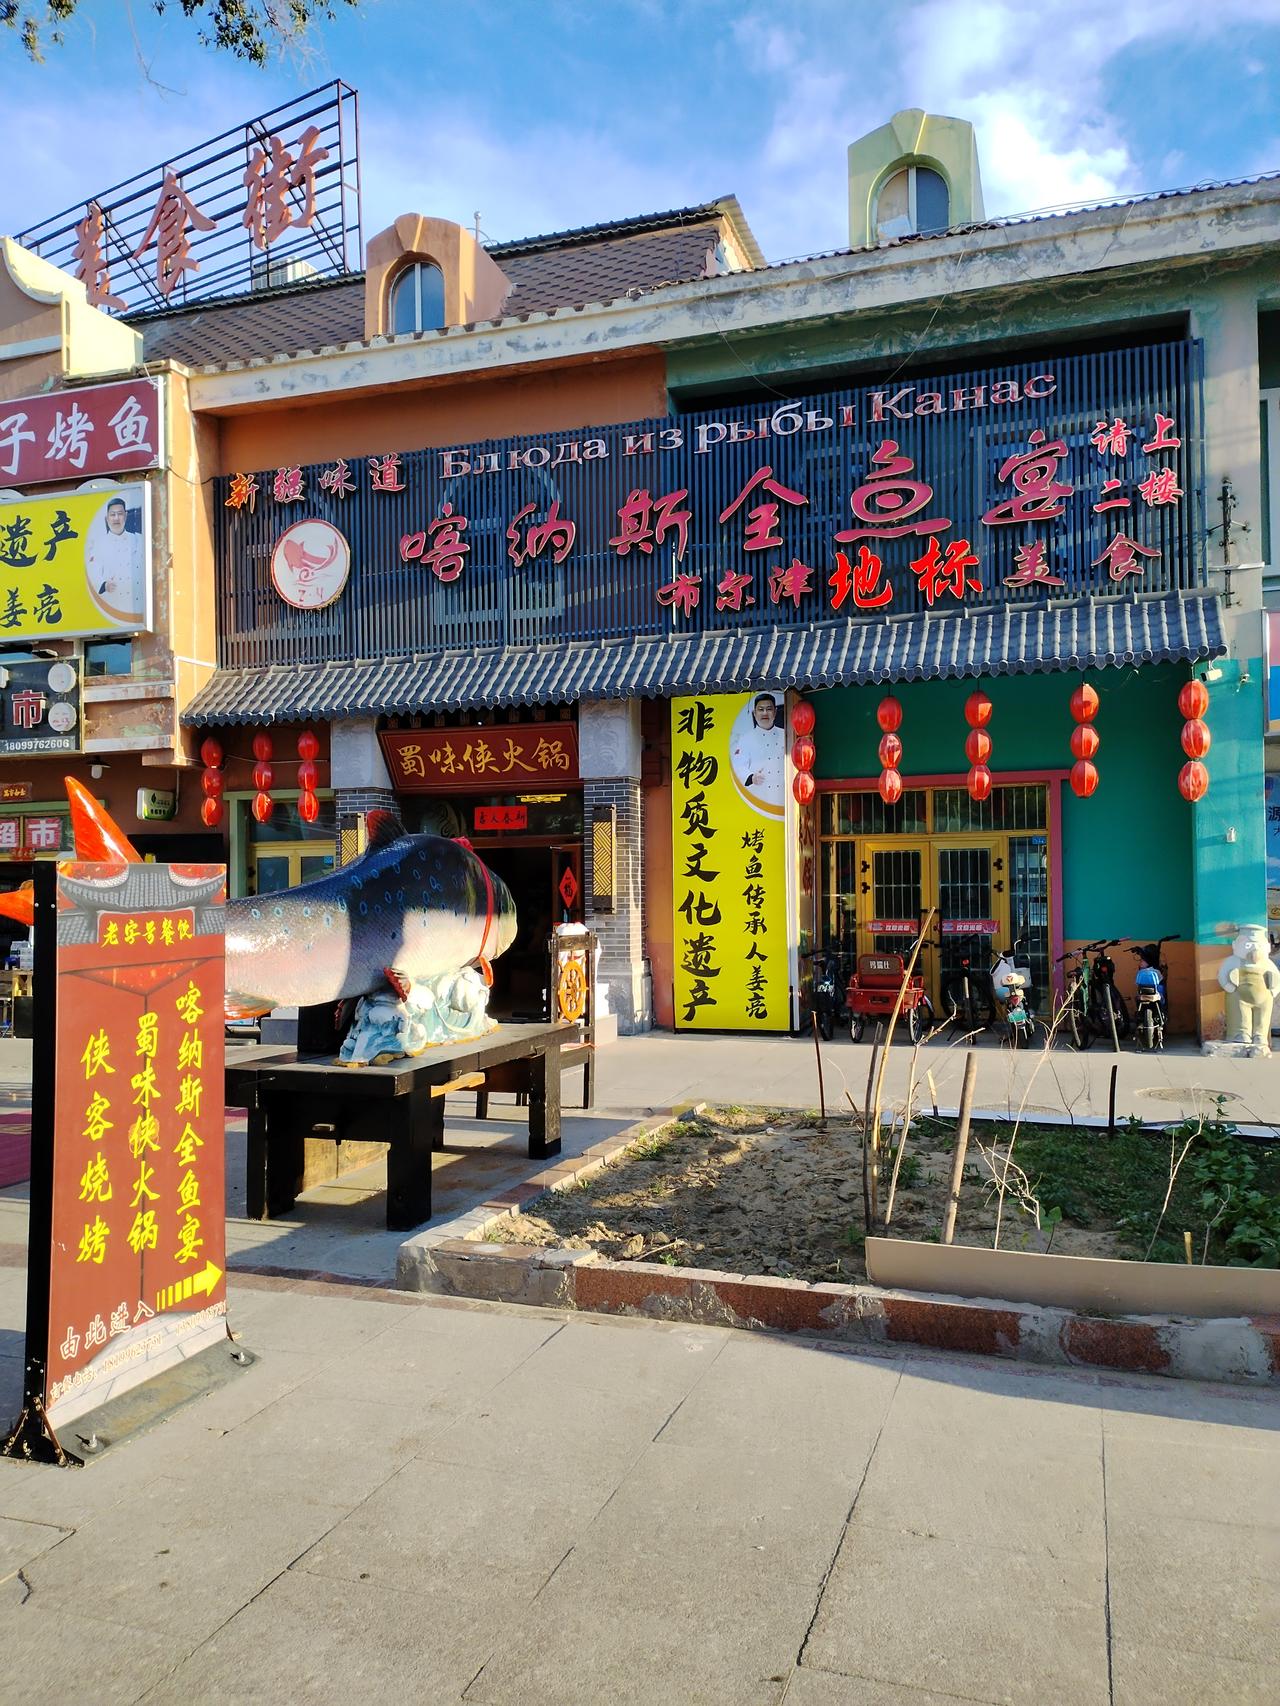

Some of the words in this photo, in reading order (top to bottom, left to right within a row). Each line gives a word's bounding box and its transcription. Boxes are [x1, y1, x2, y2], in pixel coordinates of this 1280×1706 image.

[72, 125, 330, 311] 美食街
[0, 395, 152, 476] 子烤鱼
[438, 437, 610, 480] Блюда
[622, 428, 685, 457] из
[867, 374, 1059, 424] Канас
[1091, 413, 1182, 456] 请上
[225, 452, 406, 514] 新疆味道
[1092, 468, 1184, 514] 二楼
[0, 510, 78, 568] 遗产
[0, 583, 63, 629] 姜亮
[5, 739, 70, 751] 18099762606
[396, 738, 571, 778] 蜀味侠火锅
[675, 701, 722, 1022] 非物质文化遗产
[101, 917, 194, 948] 老字号餐饮
[741, 828, 768, 1020] 烤鱼传承人姜亮
[76, 1029, 117, 1264] 侠客烧烤
[127, 1012, 161, 1254] 蜀味侠火锅
[173, 980, 204, 1264] 喀纳斯全鱼宴
[60, 1299, 156, 1361] 由此进入
